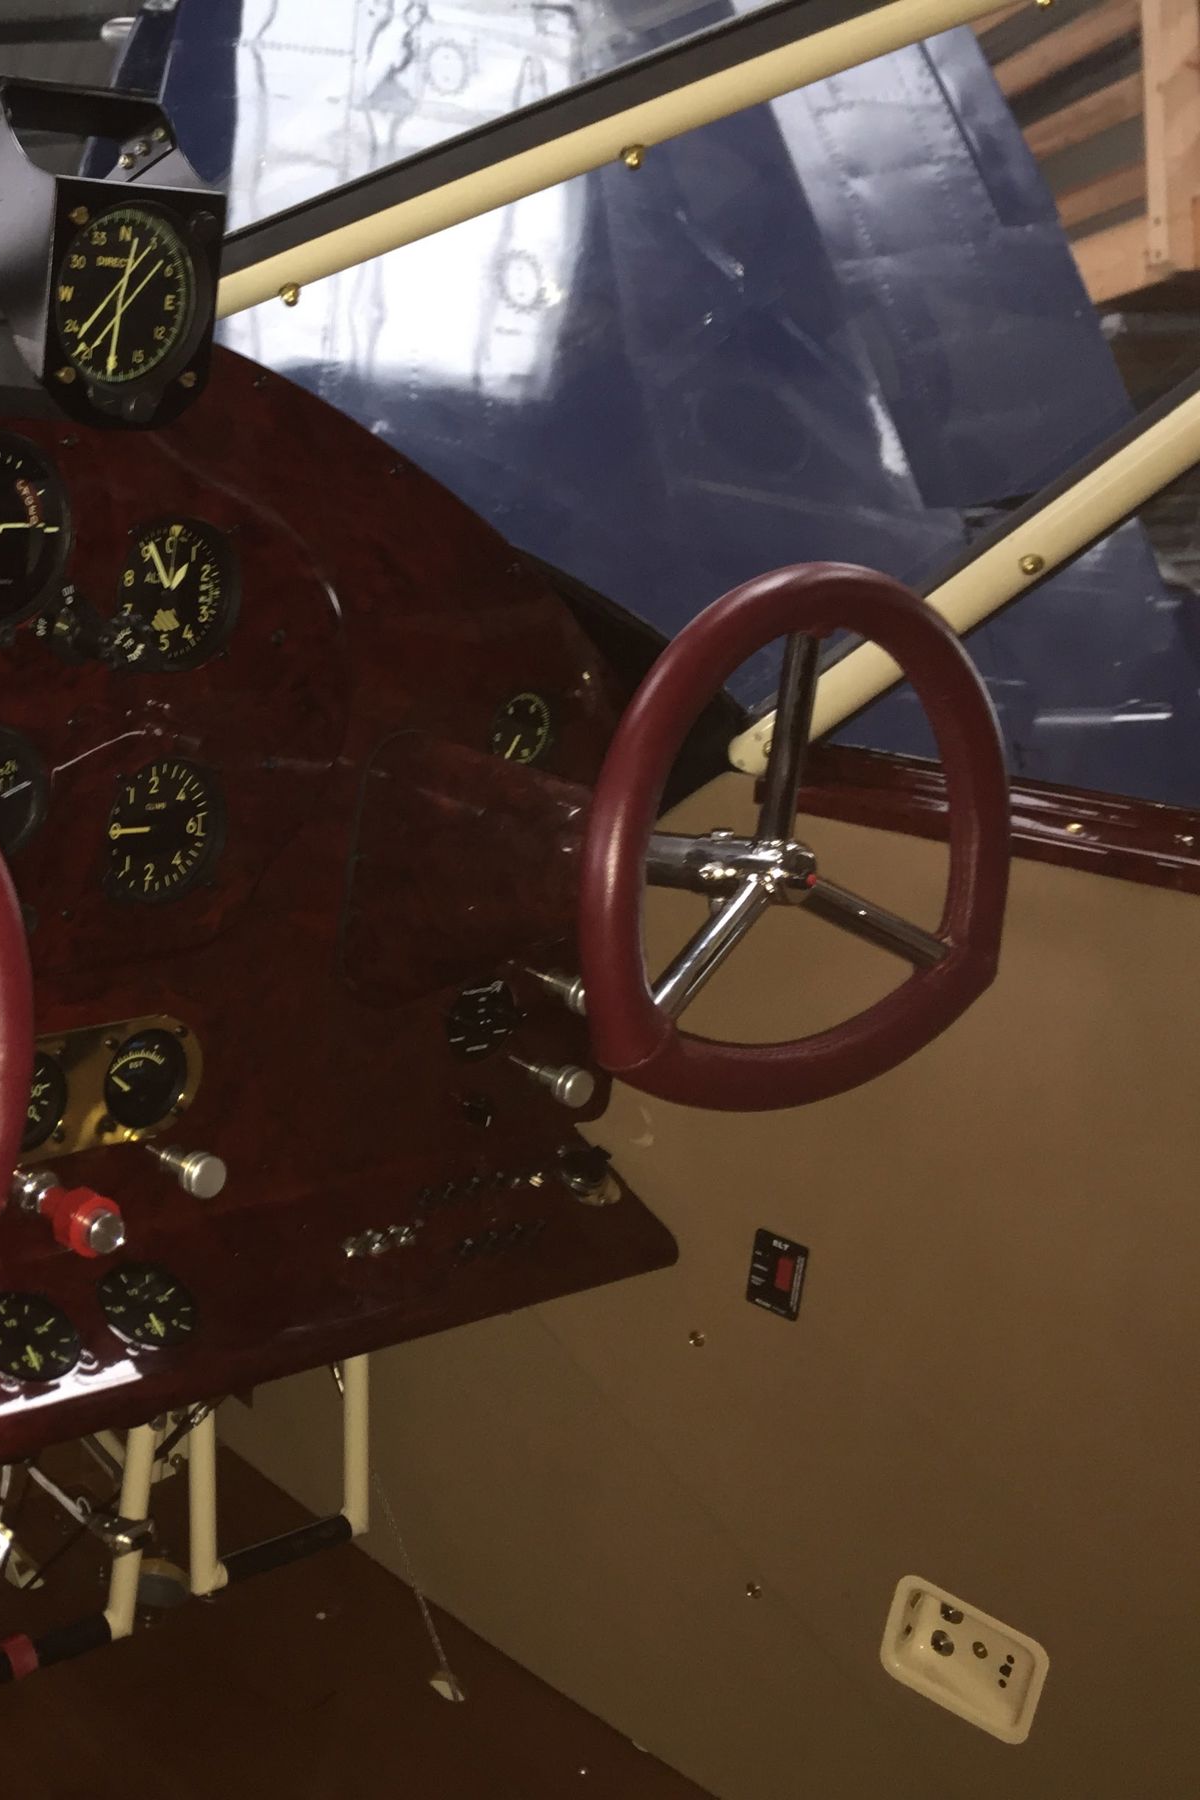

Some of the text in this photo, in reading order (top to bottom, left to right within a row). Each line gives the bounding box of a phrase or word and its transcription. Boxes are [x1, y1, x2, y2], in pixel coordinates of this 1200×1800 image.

[119, 226, 133, 241] N
[71, 256, 86, 270] 30
[164, 262, 174, 276] 6
[59, 285, 74, 301] W
[164, 294, 176, 311] E
[64, 319, 79, 333] 24
[123, 569, 134, 587] 8
[201, 564, 211, 581] 2
[198, 606, 209, 622] 3
[182, 624, 194, 639] 4
[159, 633, 170, 650] 5
[149, 776, 159, 794] 2
[129, 787, 135, 804] 1
[176, 788, 186, 801] 4
[109, 822, 121, 840] 0
[186, 817, 197, 834] 6
[125, 855, 131, 872] 1
[171, 851, 182, 865] 4
[144, 863, 155, 880] 2
